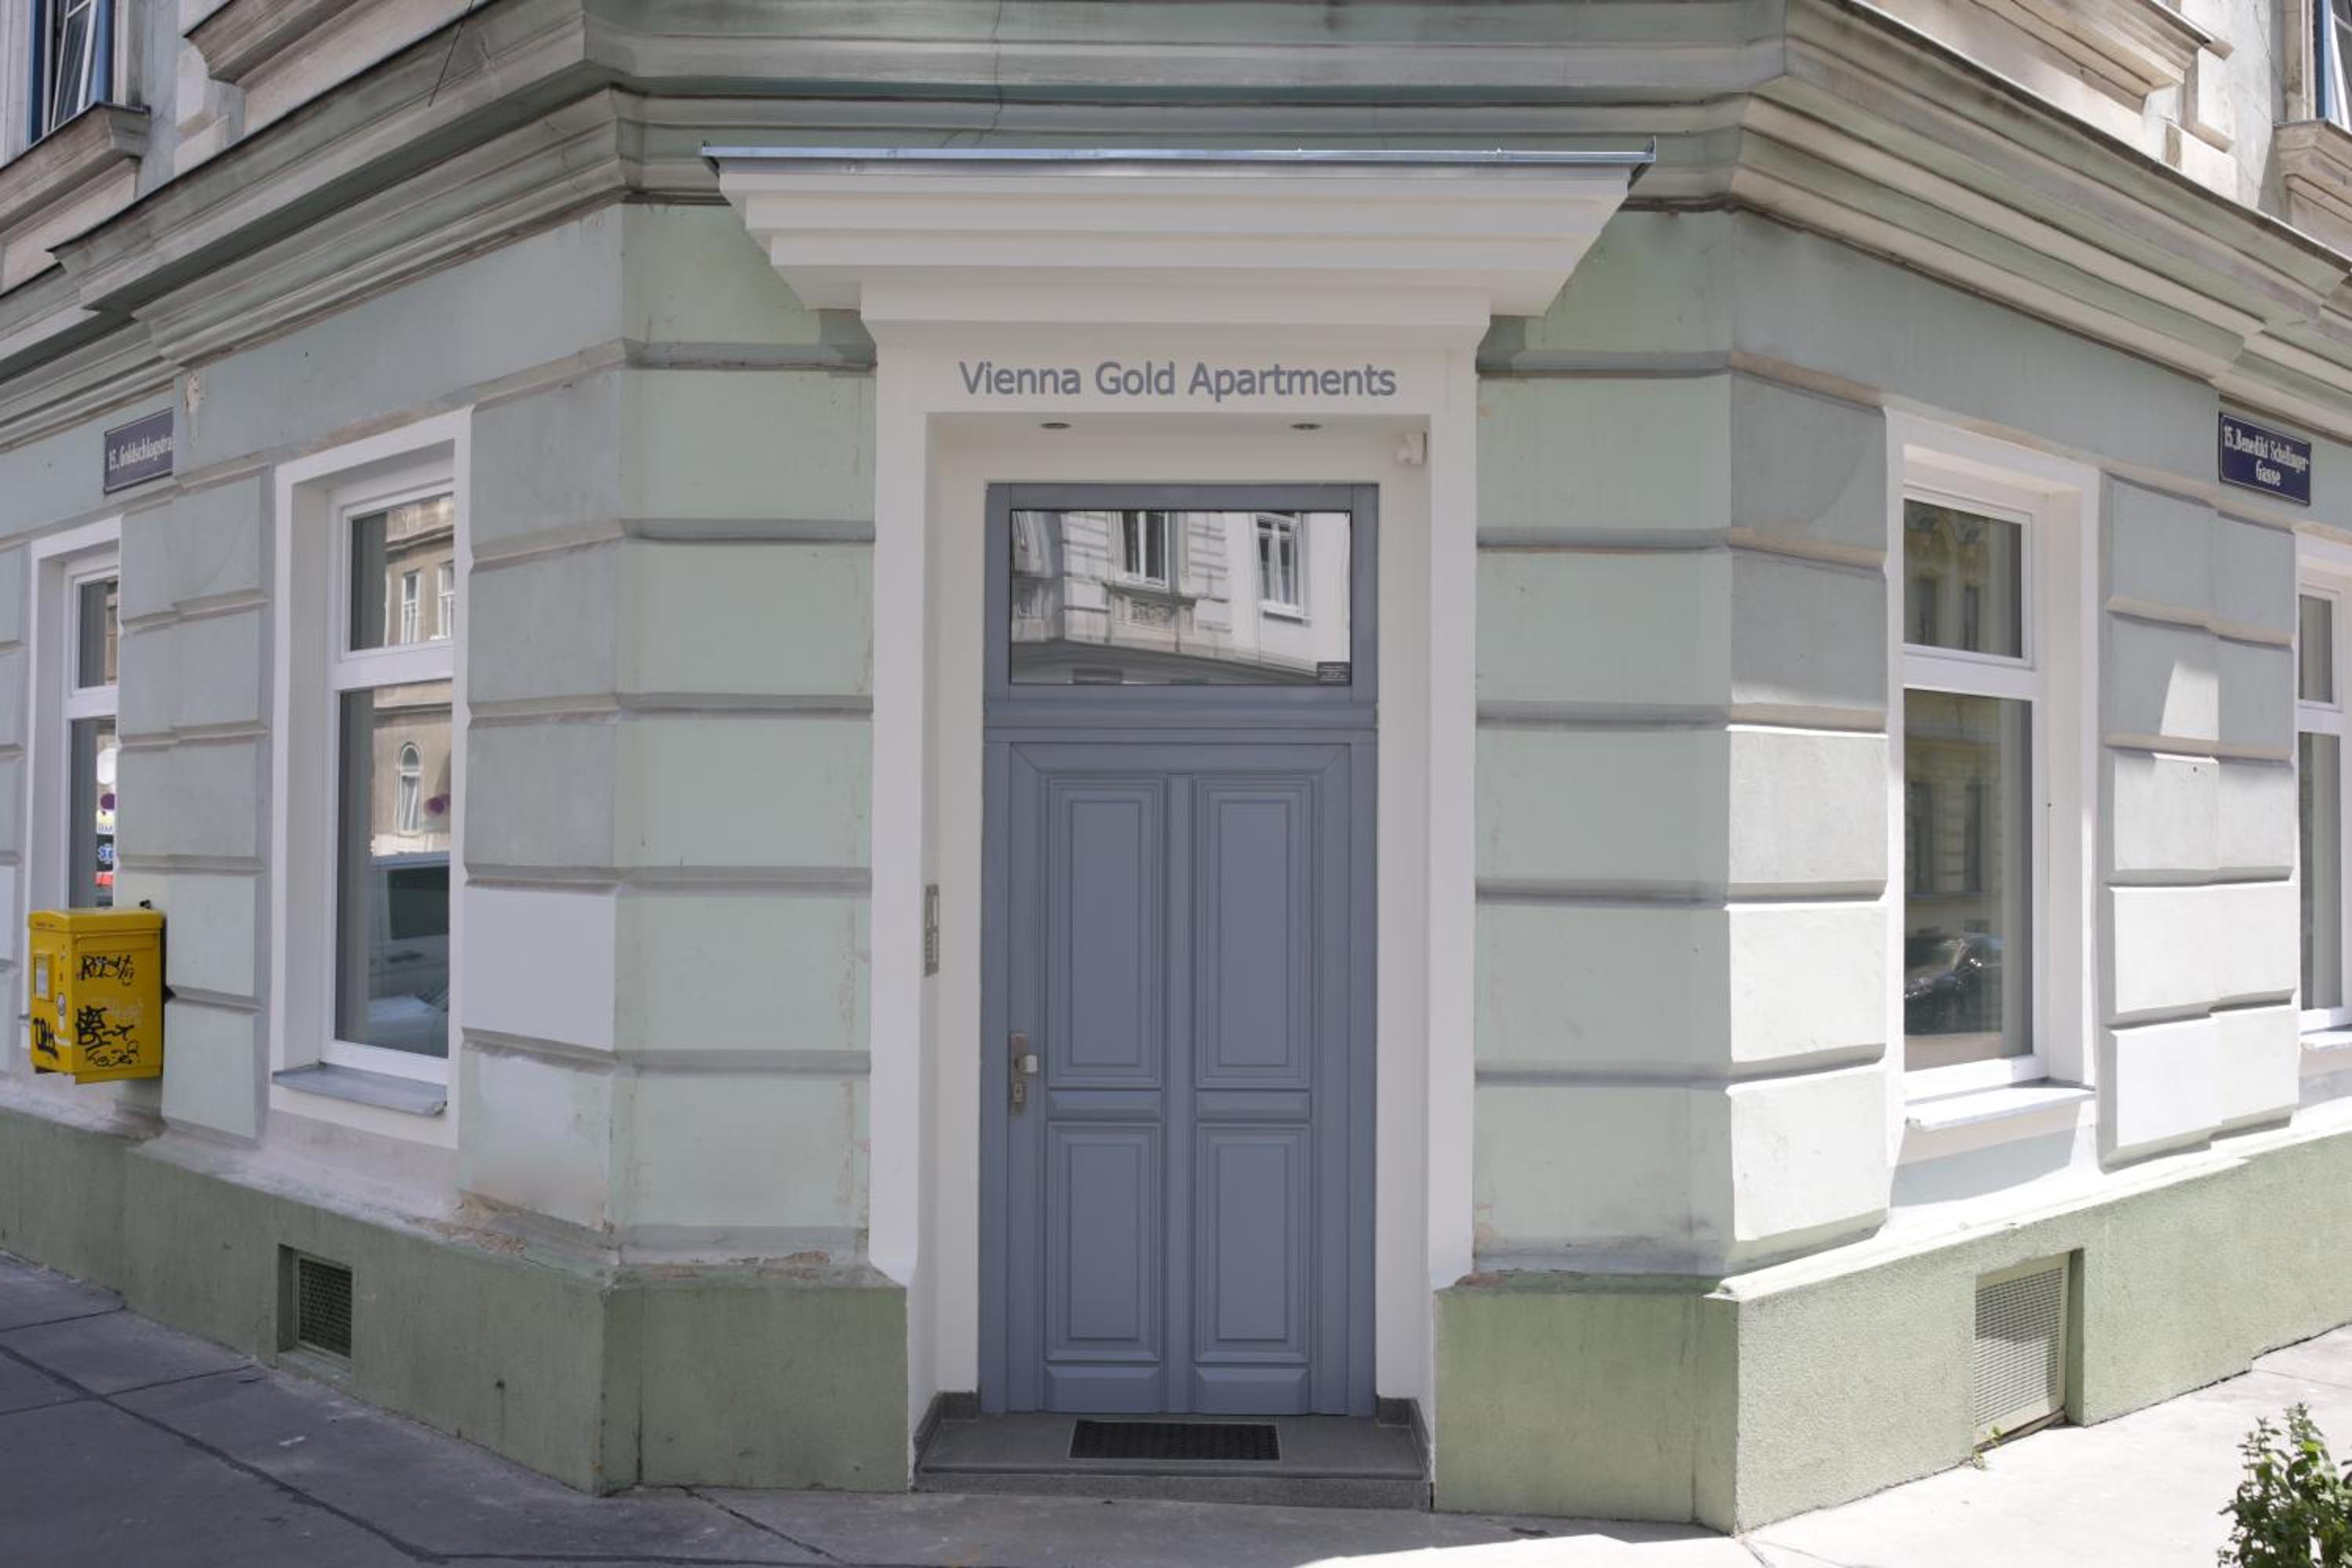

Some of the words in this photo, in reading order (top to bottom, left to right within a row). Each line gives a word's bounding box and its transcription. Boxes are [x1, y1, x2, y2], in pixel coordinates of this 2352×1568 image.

[959, 361, 1082, 395] Vienna
[1095, 361, 1176, 395] Gold
[1189, 361, 1397, 403] Apartments
[2256, 459, 2281, 486] Gasse
